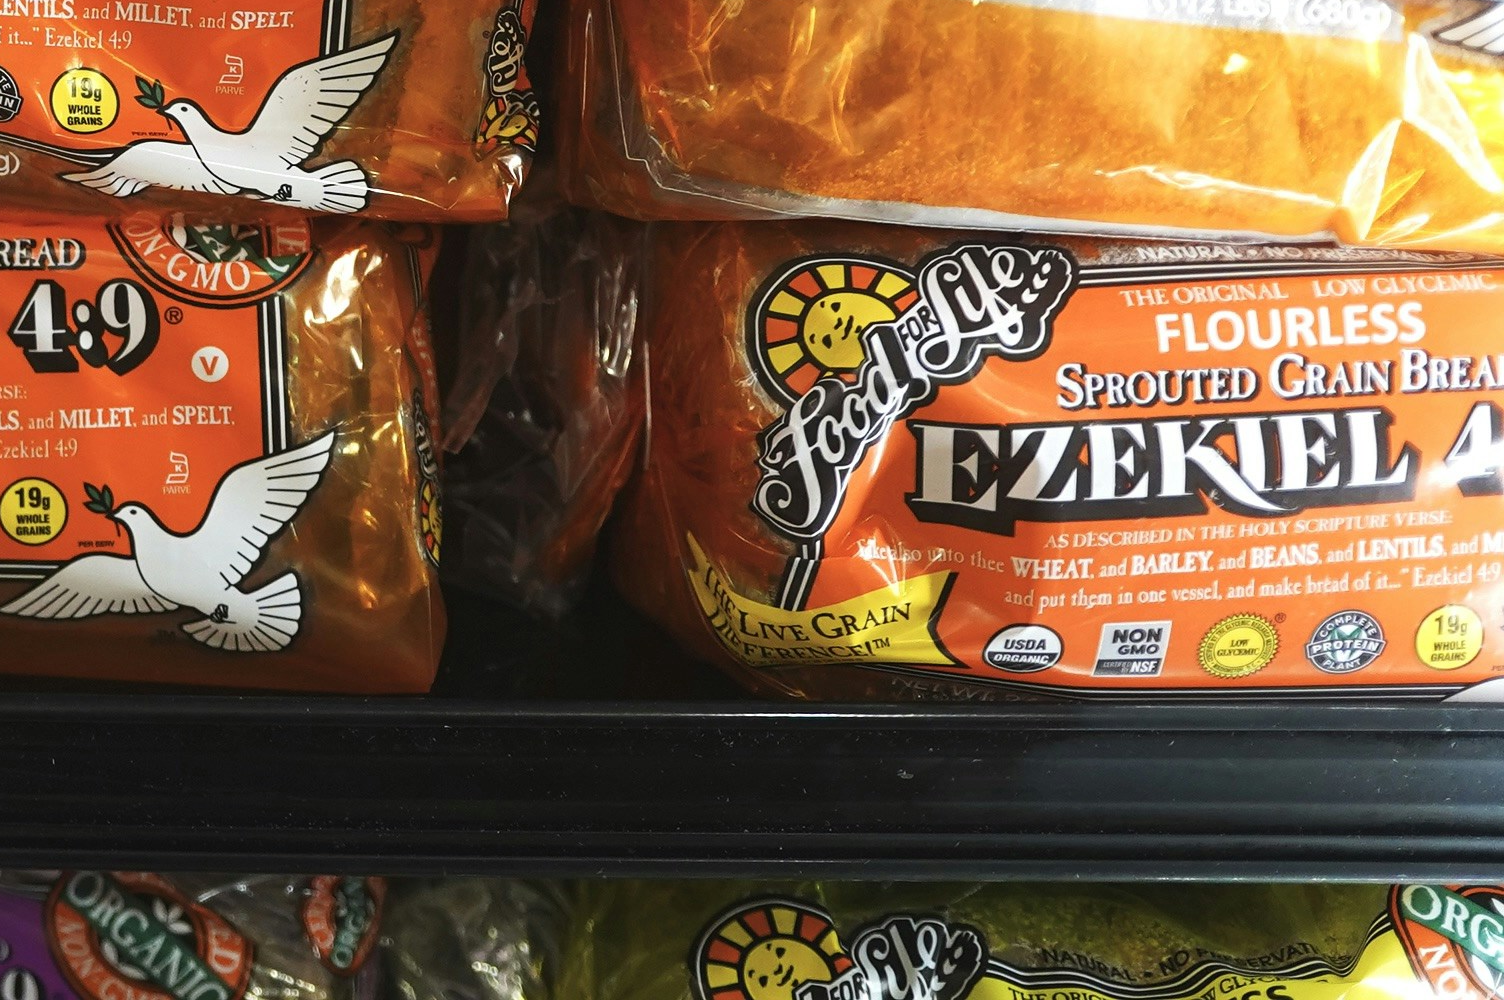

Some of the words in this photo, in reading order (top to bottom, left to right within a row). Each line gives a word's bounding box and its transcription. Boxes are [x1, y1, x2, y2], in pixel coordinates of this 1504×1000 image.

[114, 1, 195, 29] MILLET,
[230, 9, 295, 31] SPELT,
[44, 27, 105, 50] Ezekiel
[107, 29, 133, 50] 4:9
[215, 85, 245, 96] PARVE
[66, 116, 104, 128] GRAINS
[67, 104, 102, 117] WHOLE
[1119, 288, 1168, 307] THE
[1172, 282, 1288, 306] ORIGINAL
[1312, 277, 1367, 298] LOW
[1371, 273, 1496, 296] GLYCEMIC
[12, 281, 148, 364] 4:9
[897, 308, 938, 352] FOR
[1154, 301, 1428, 355] FLOURLESS
[1055, 362, 1257, 410] SPROUTED
[1269, 353, 1392, 400] GRAIN
[58, 407, 136, 430] MILLET,
[171, 405, 235, 427] SPELT,
[907, 408, 1412, 513] EZEKIEL
[1131, 552, 1214, 577] BARLEY,
[1249, 544, 1321, 569] BEANS,
[1356, 537, 1448, 563] LENTILS,
[737, 609, 811, 643] LIVE
[811, 601, 913, 639] GRAIN
[993, 652, 1052, 667] ORGANIC
[1003, 638, 1048, 652] USDA
[1310, 640, 1381, 655] PROTEIN
[1041, 947, 1138, 983] NATURAL
[1157, 950, 1192, 977] NO
